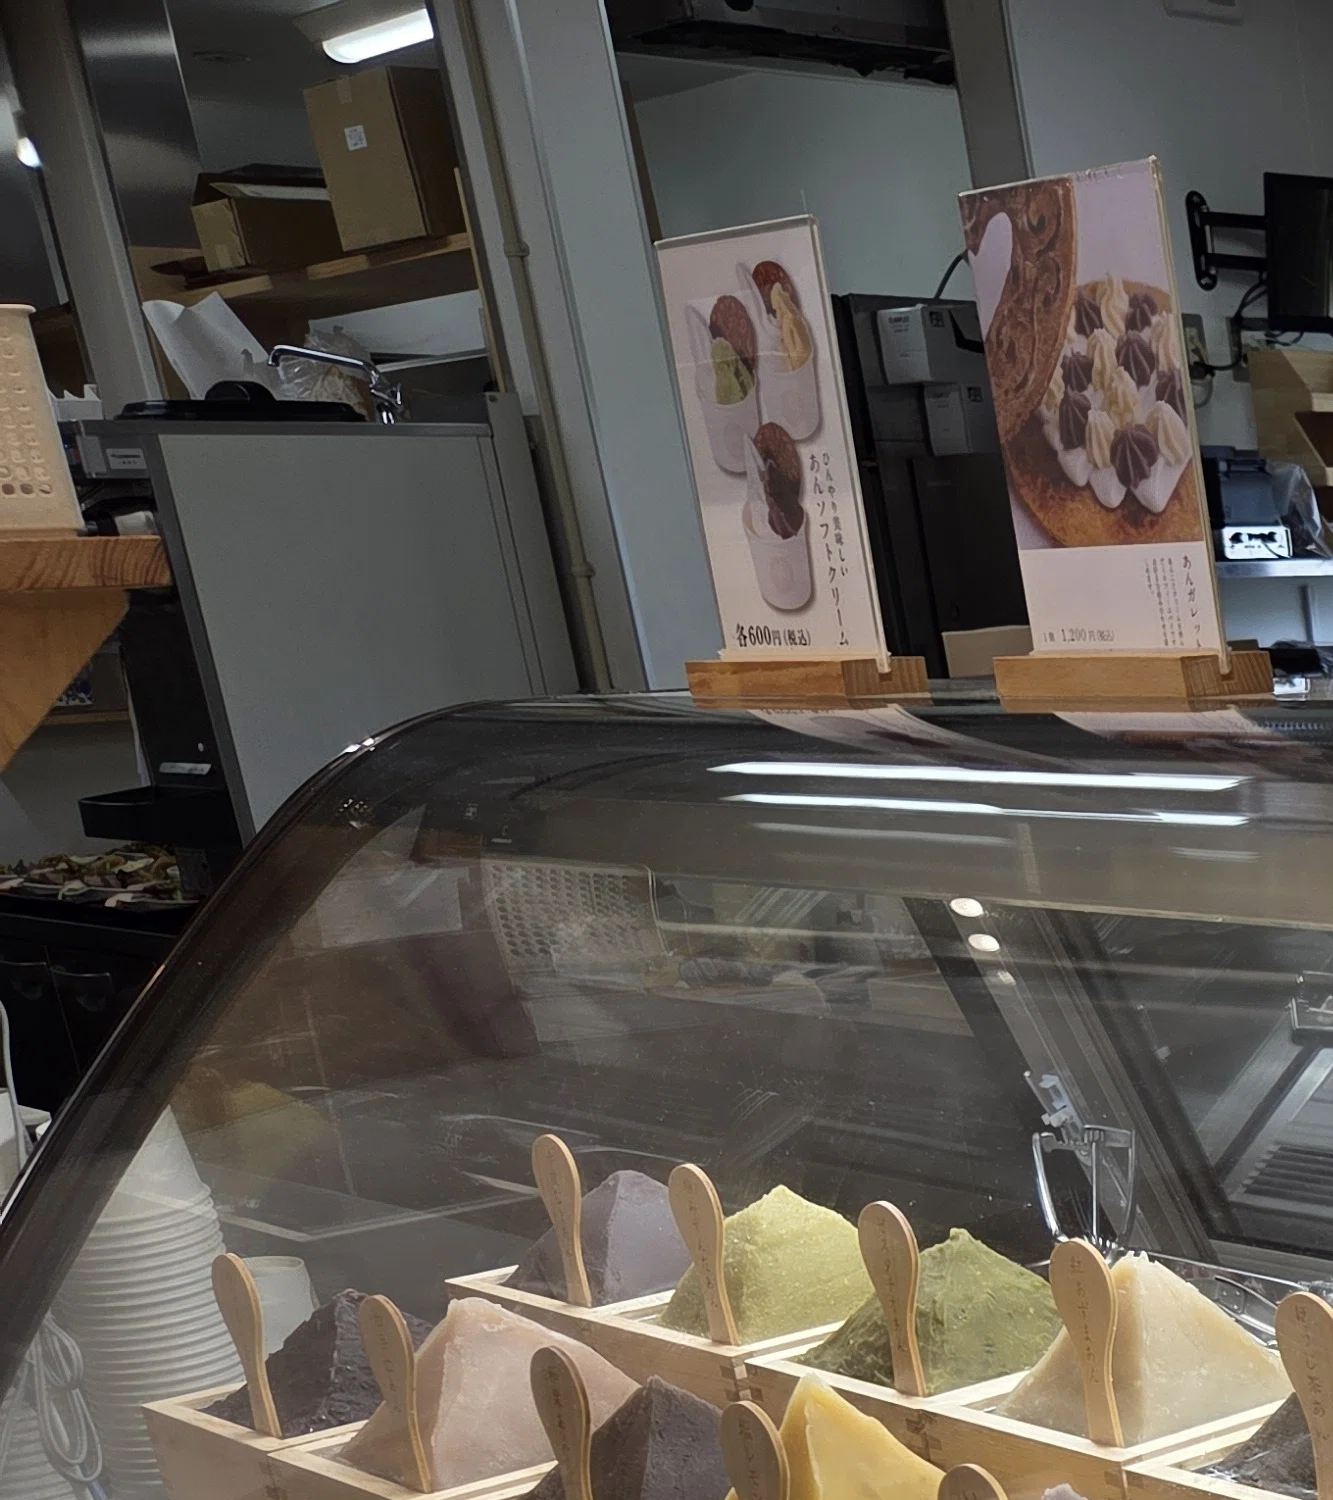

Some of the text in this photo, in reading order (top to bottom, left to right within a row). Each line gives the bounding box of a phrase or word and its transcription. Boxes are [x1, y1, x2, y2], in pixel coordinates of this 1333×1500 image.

[809, 453, 850, 646] あんソフトクリーム
